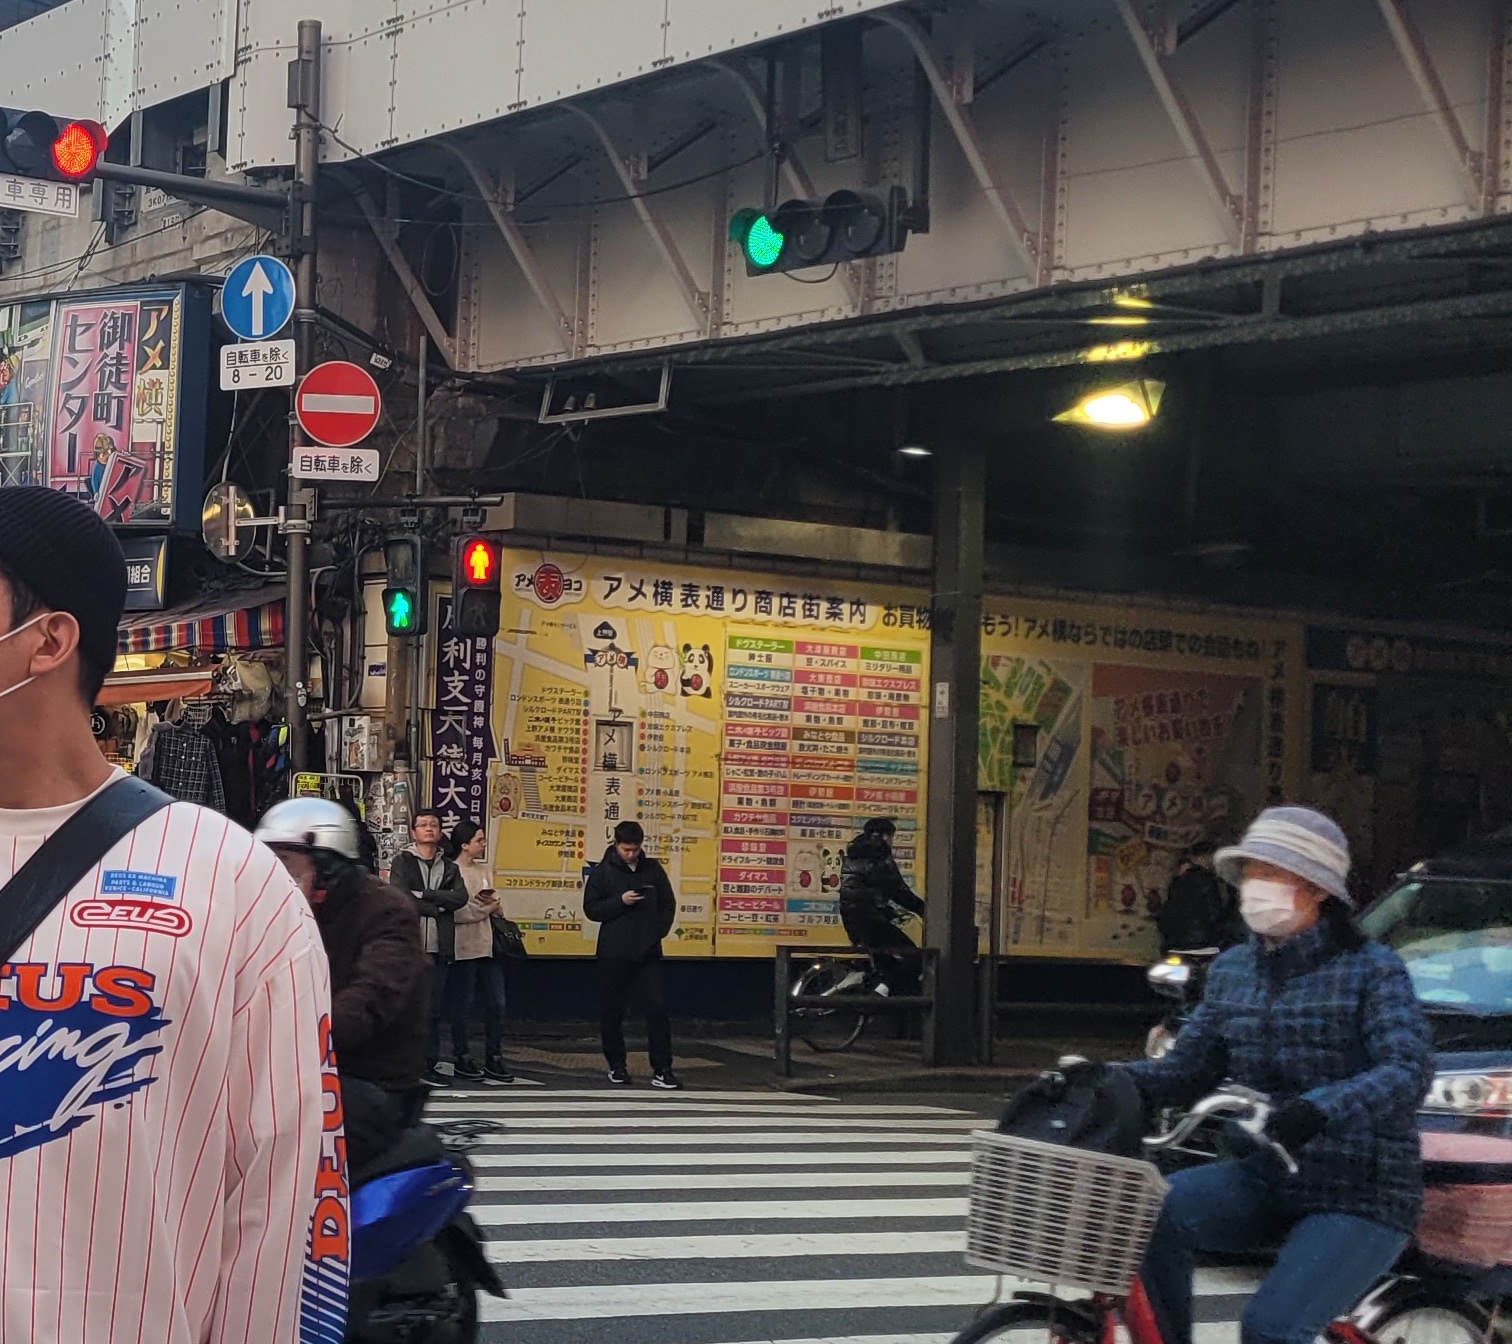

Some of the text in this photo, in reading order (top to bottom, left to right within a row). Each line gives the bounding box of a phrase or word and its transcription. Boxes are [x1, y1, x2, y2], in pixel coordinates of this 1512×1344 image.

[93, 310, 133, 431] 御徒町
[136, 306, 169, 416] アメ横
[226, 346, 290, 366] 自転車を除く
[232, 369, 241, 384] 8
[264, 365, 283, 382] 20
[59, 312, 97, 474] センター
[299, 454, 373, 475] 自転車を除く
[126, 565, 152, 585] 組合
[602, 574, 868, 625] アメ横表通り商店街案内
